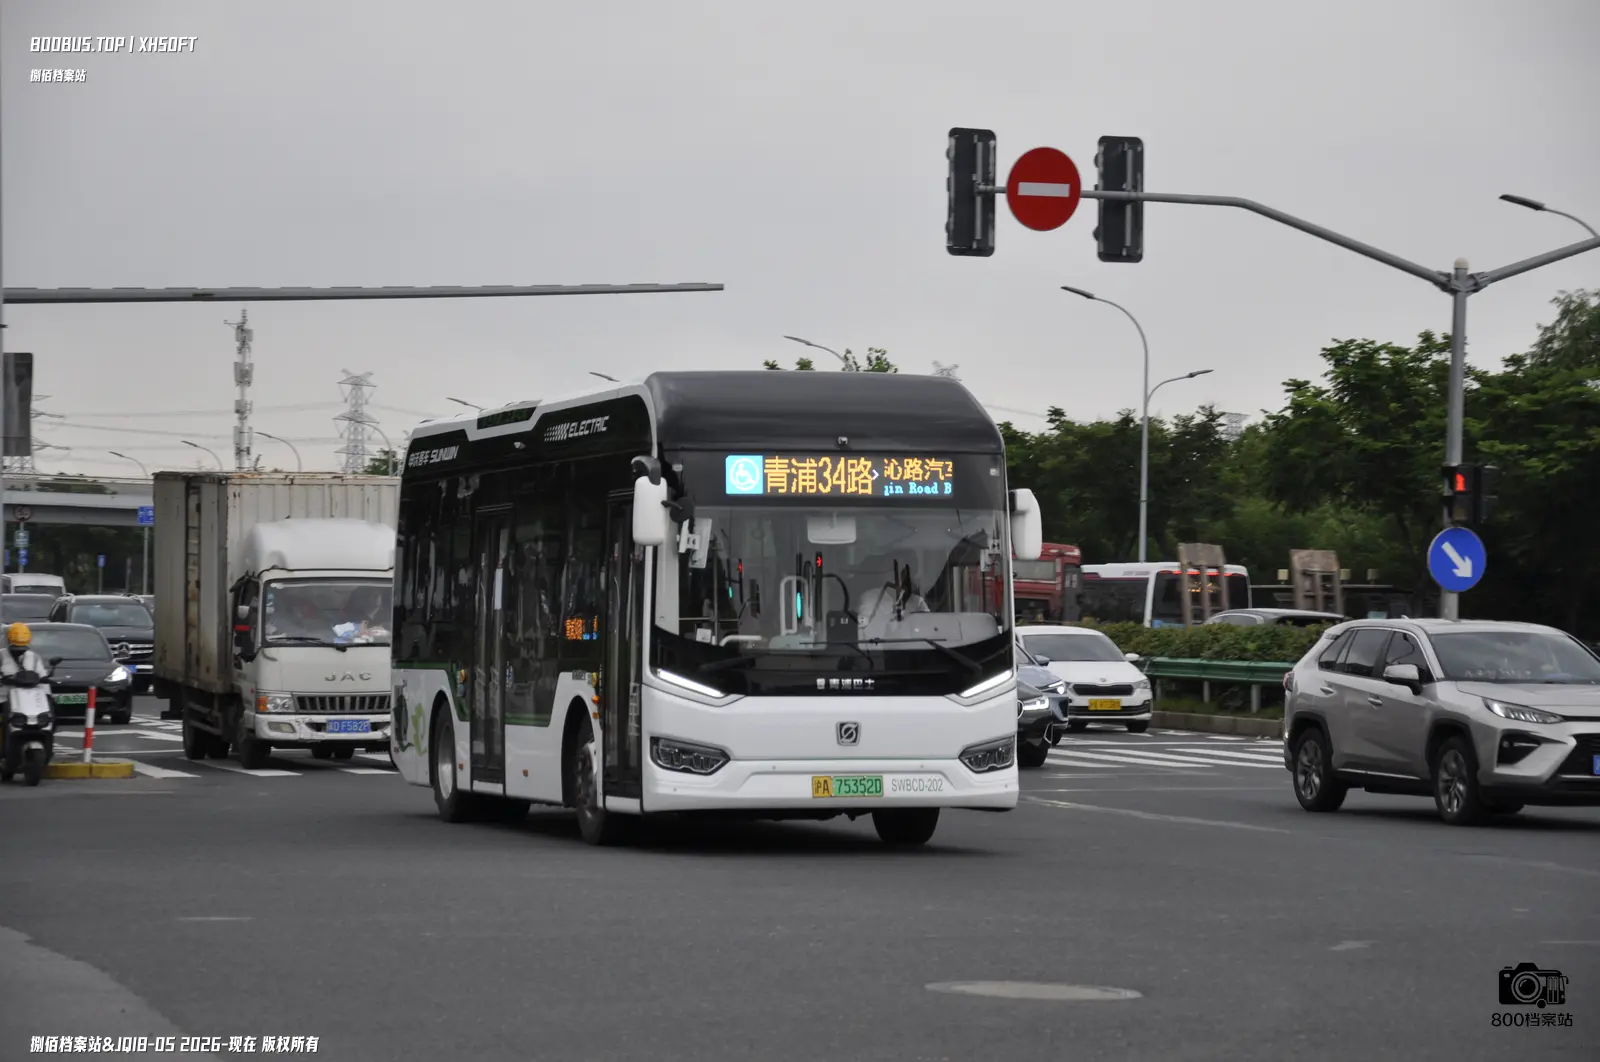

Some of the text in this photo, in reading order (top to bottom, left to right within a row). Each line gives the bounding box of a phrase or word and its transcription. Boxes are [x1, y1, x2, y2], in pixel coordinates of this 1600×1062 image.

[567, 415, 610, 438] ELECTRIC
[763, 455, 873, 495] 青浦34路
[908, 481, 939, 495] Road
[324, 672, 372, 682] JAC
[891, 778, 944, 792] SWBCD-202
